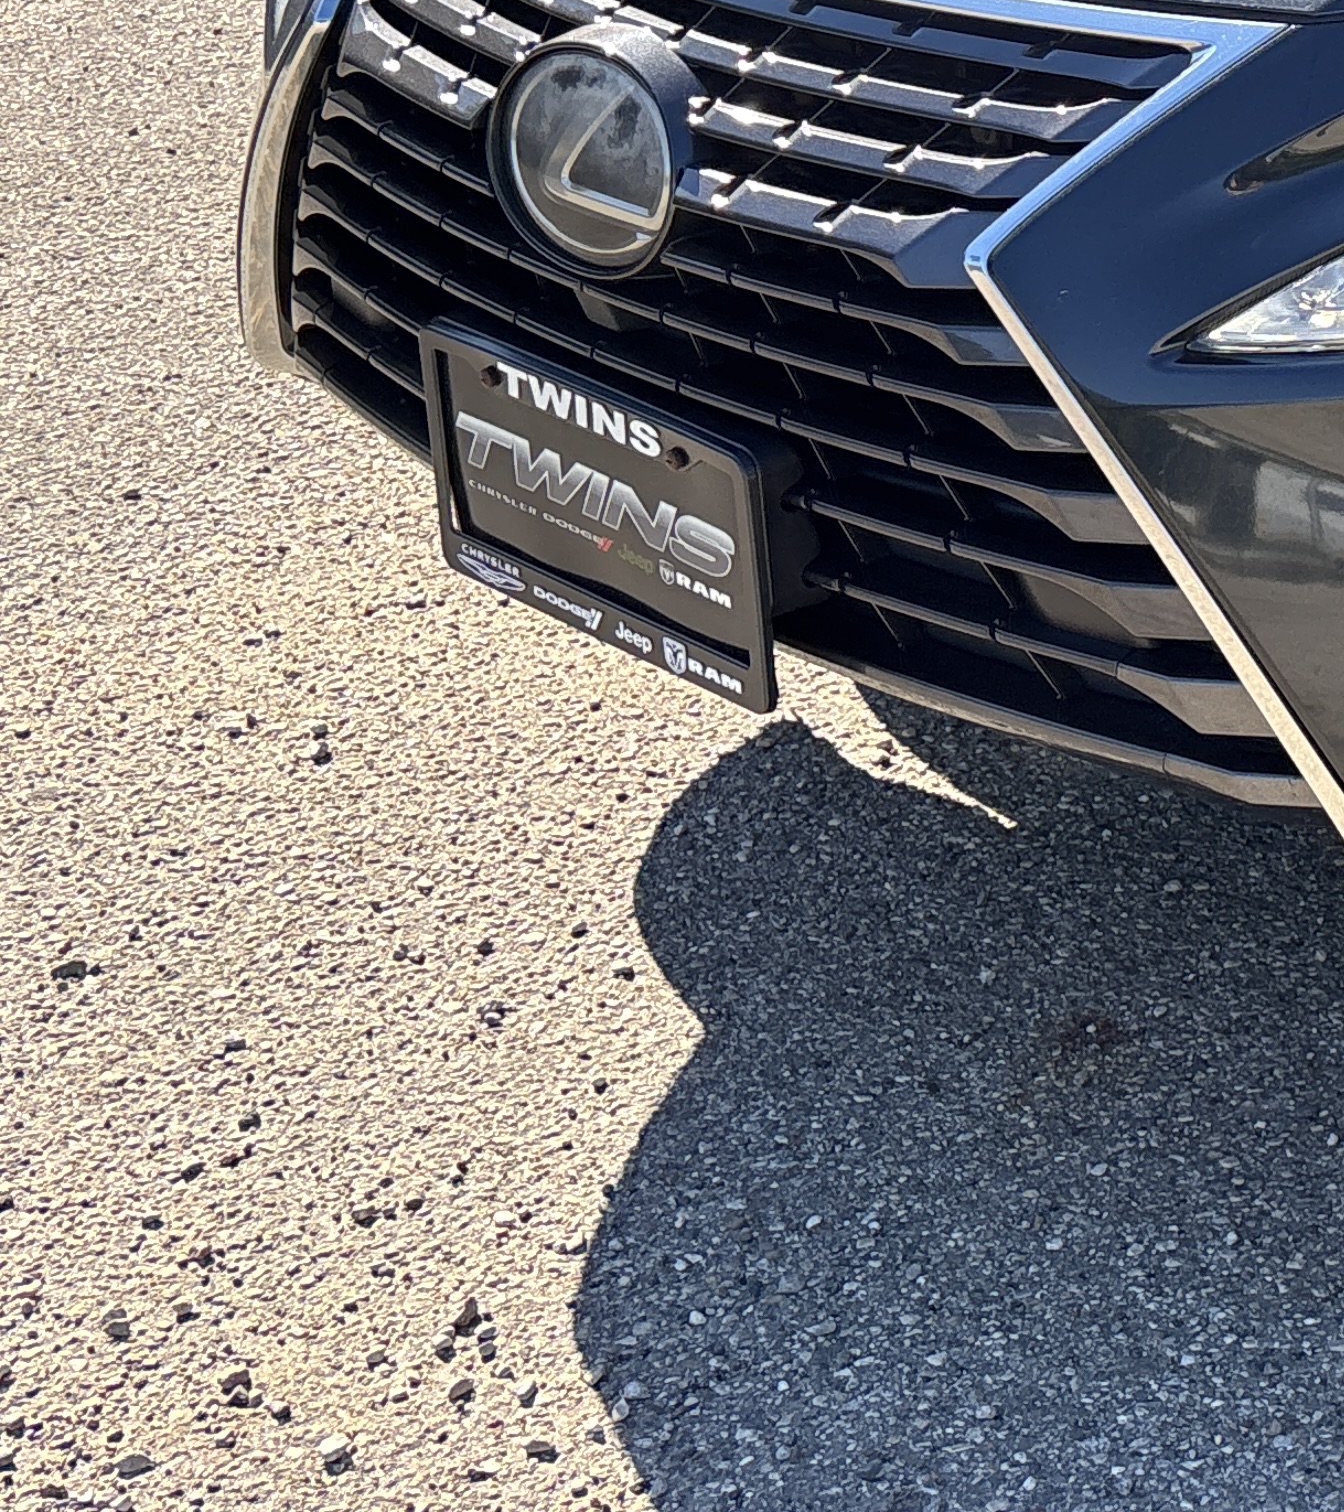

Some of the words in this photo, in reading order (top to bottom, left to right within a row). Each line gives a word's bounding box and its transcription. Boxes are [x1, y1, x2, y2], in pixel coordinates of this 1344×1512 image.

[496, 361, 662, 458] TWINS
[456, 411, 736, 578] TWINS
[468, 479, 537, 516] CHRYSLER
[542, 512, 604, 546] DODGE
[617, 544, 655, 575] Jeep
[675, 571, 733, 609] RAM
[461, 543, 521, 579] CHRYSLER
[533, 585, 593, 620] DODGE
[614, 621, 653, 655] Jeep
[687, 657, 743, 695] RAM
